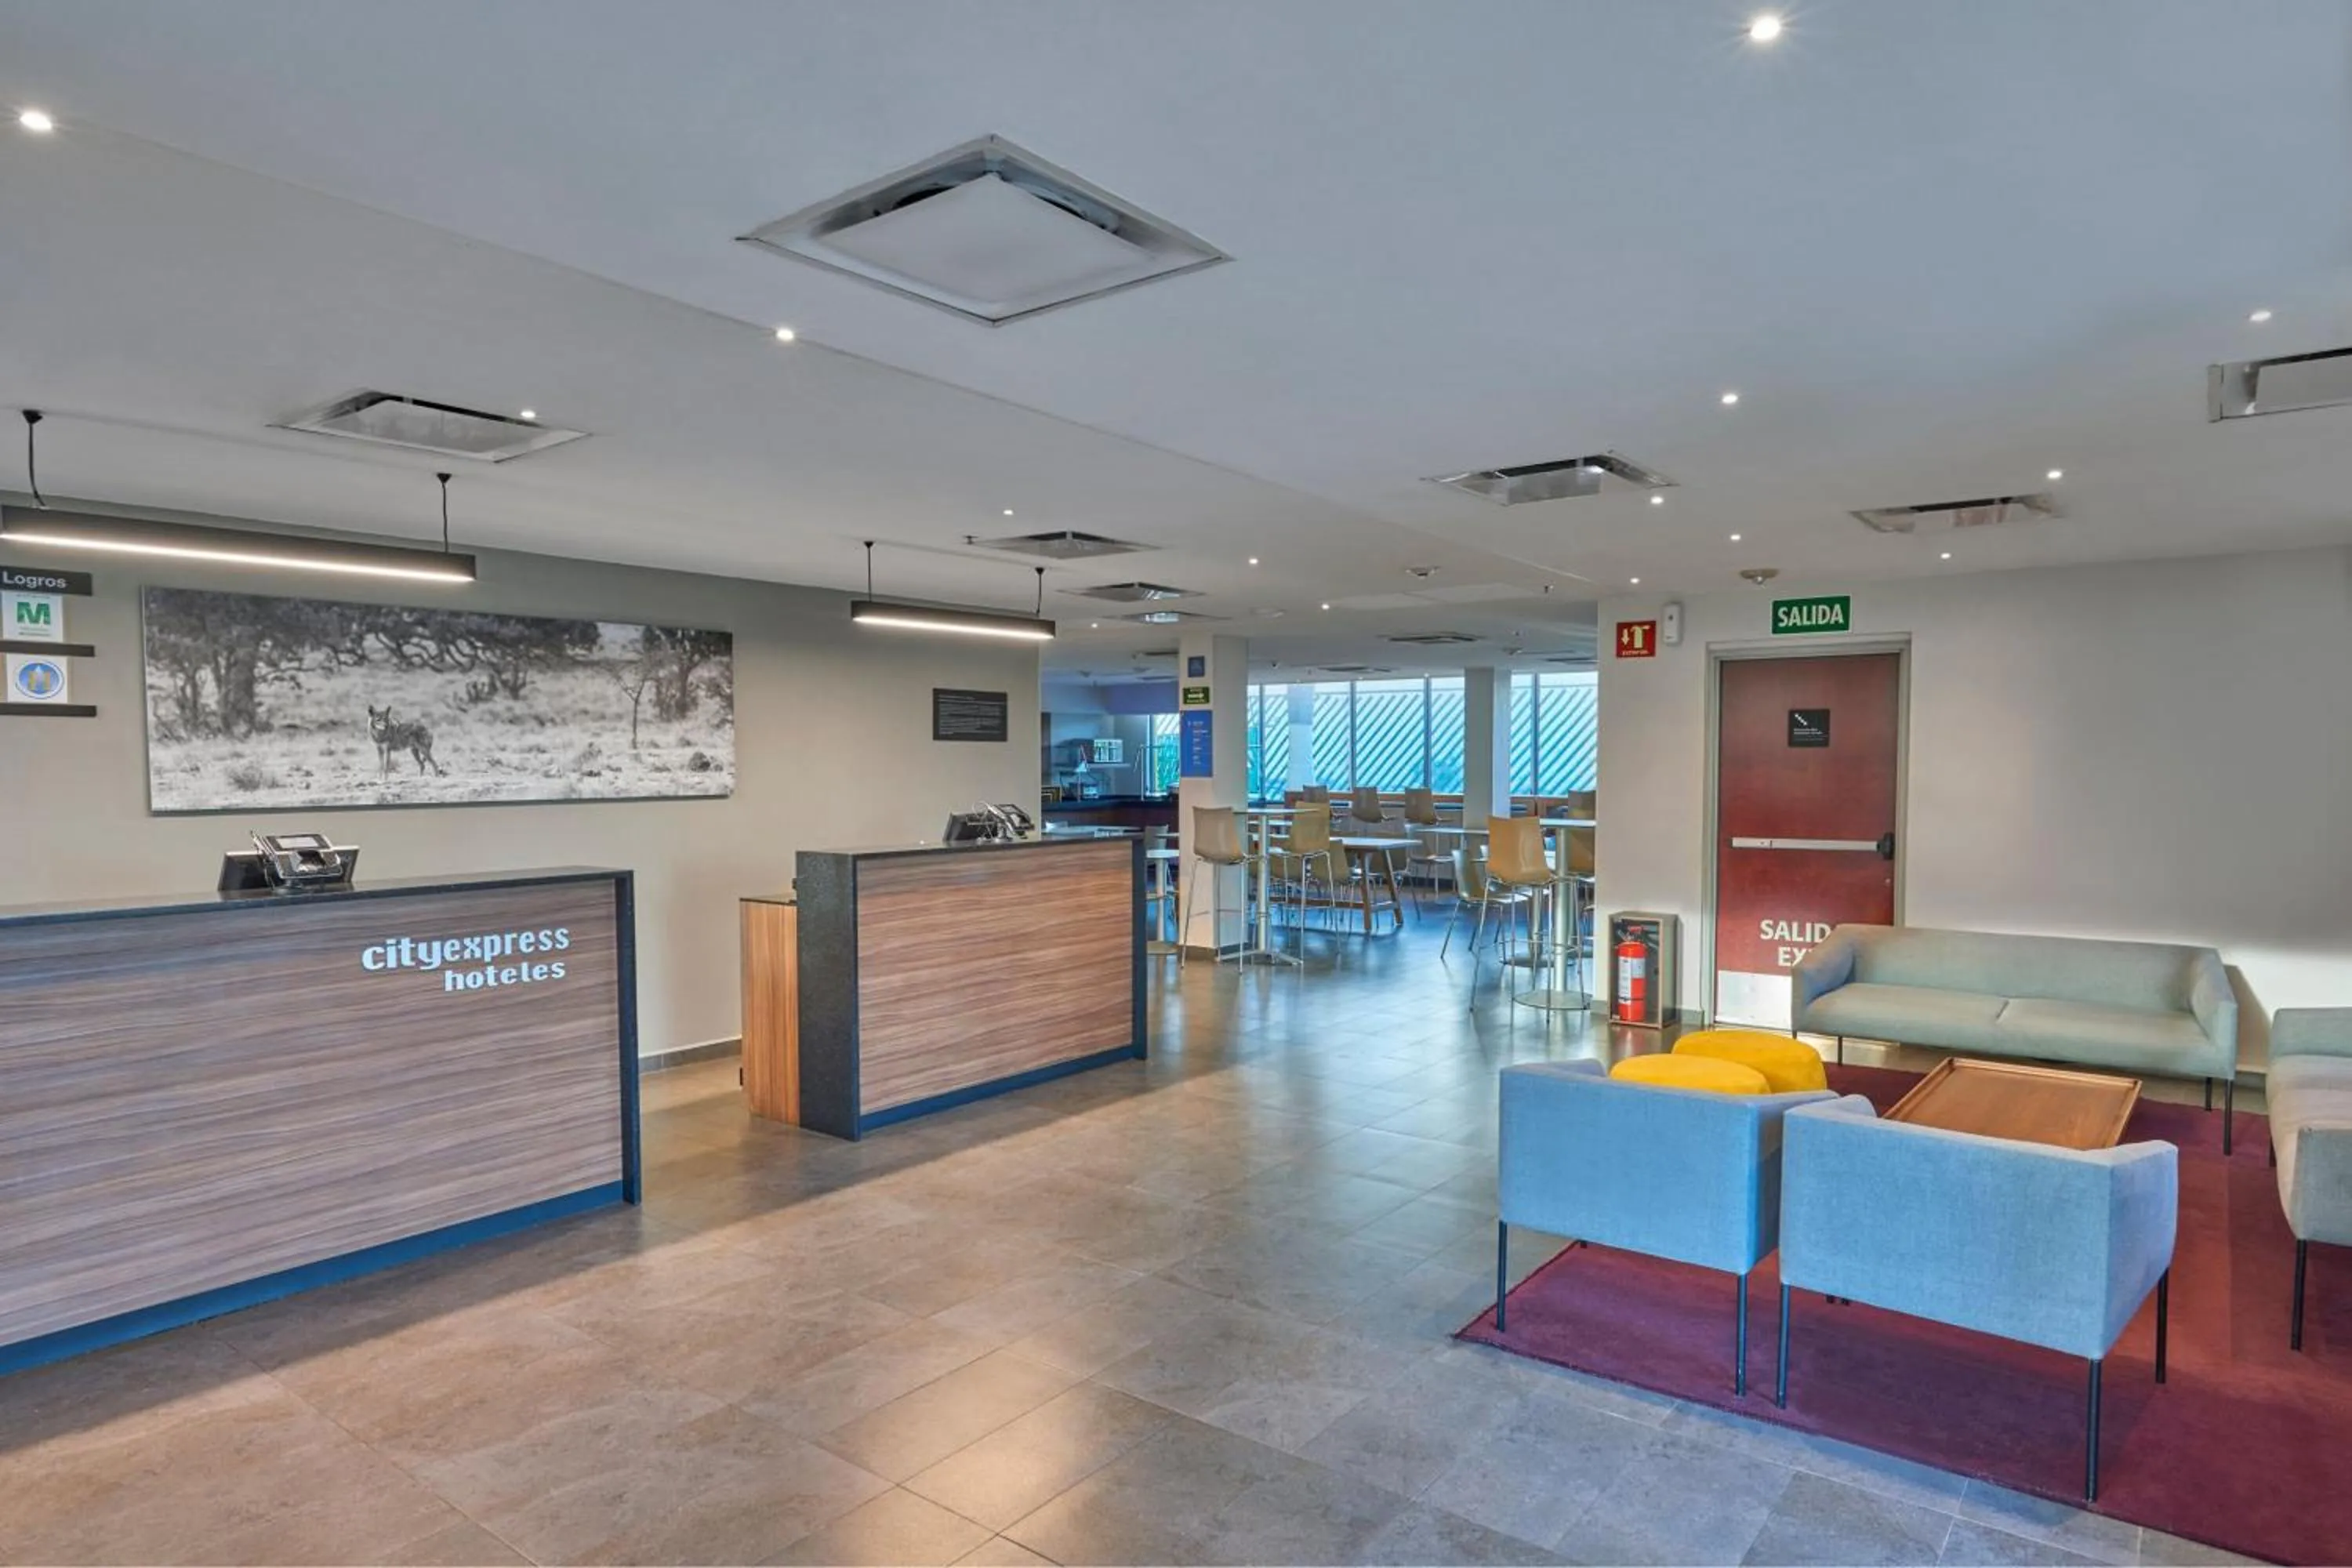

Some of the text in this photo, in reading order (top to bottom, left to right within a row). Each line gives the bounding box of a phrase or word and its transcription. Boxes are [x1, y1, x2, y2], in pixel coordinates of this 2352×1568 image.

[3, 571, 67, 588] Logros
[16, 601, 51, 625] M
[1777, 603, 1844, 627] SALIDA
[1760, 919, 1831, 943] SALID
[361, 927, 570, 970] cityexpress
[1777, 946, 1814, 967] EX
[444, 961, 566, 992] hoteles
